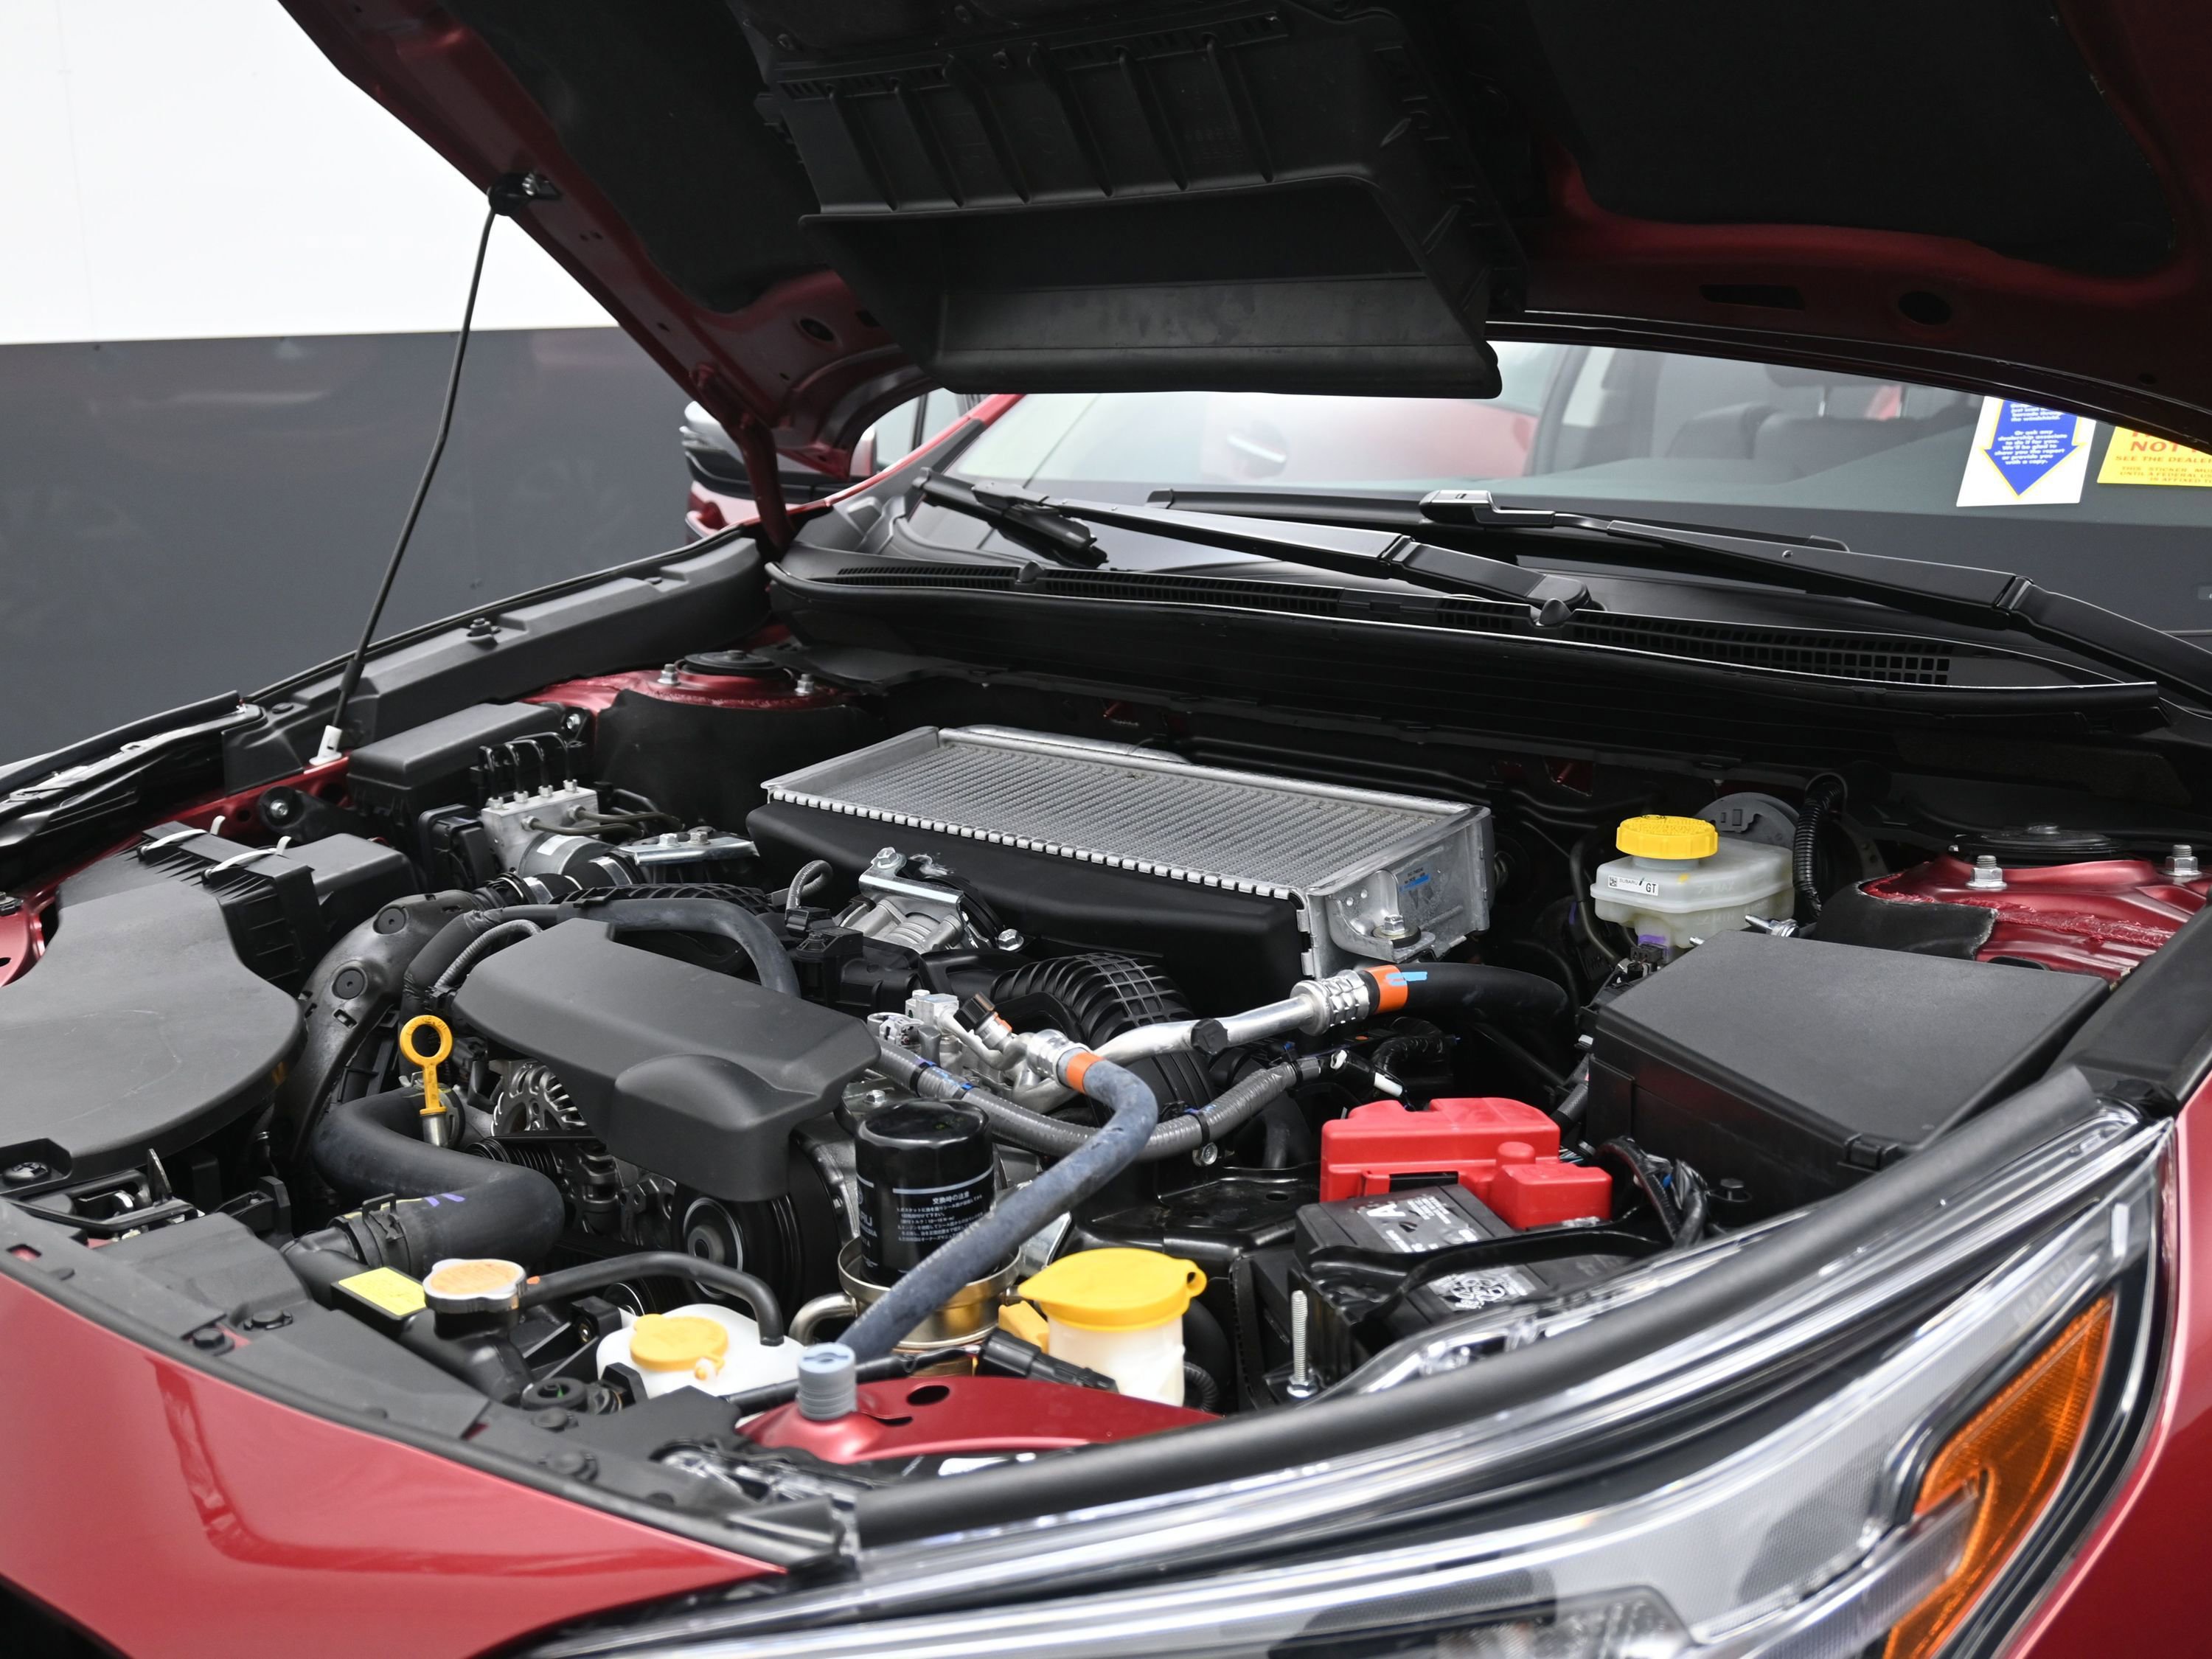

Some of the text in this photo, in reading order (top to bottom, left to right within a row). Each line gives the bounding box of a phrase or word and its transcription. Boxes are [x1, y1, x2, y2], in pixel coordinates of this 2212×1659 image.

[2130, 441, 2179, 452] NOT
[1619, 877, 1638, 886] SUBARU
[1645, 883, 1657, 894] GT
